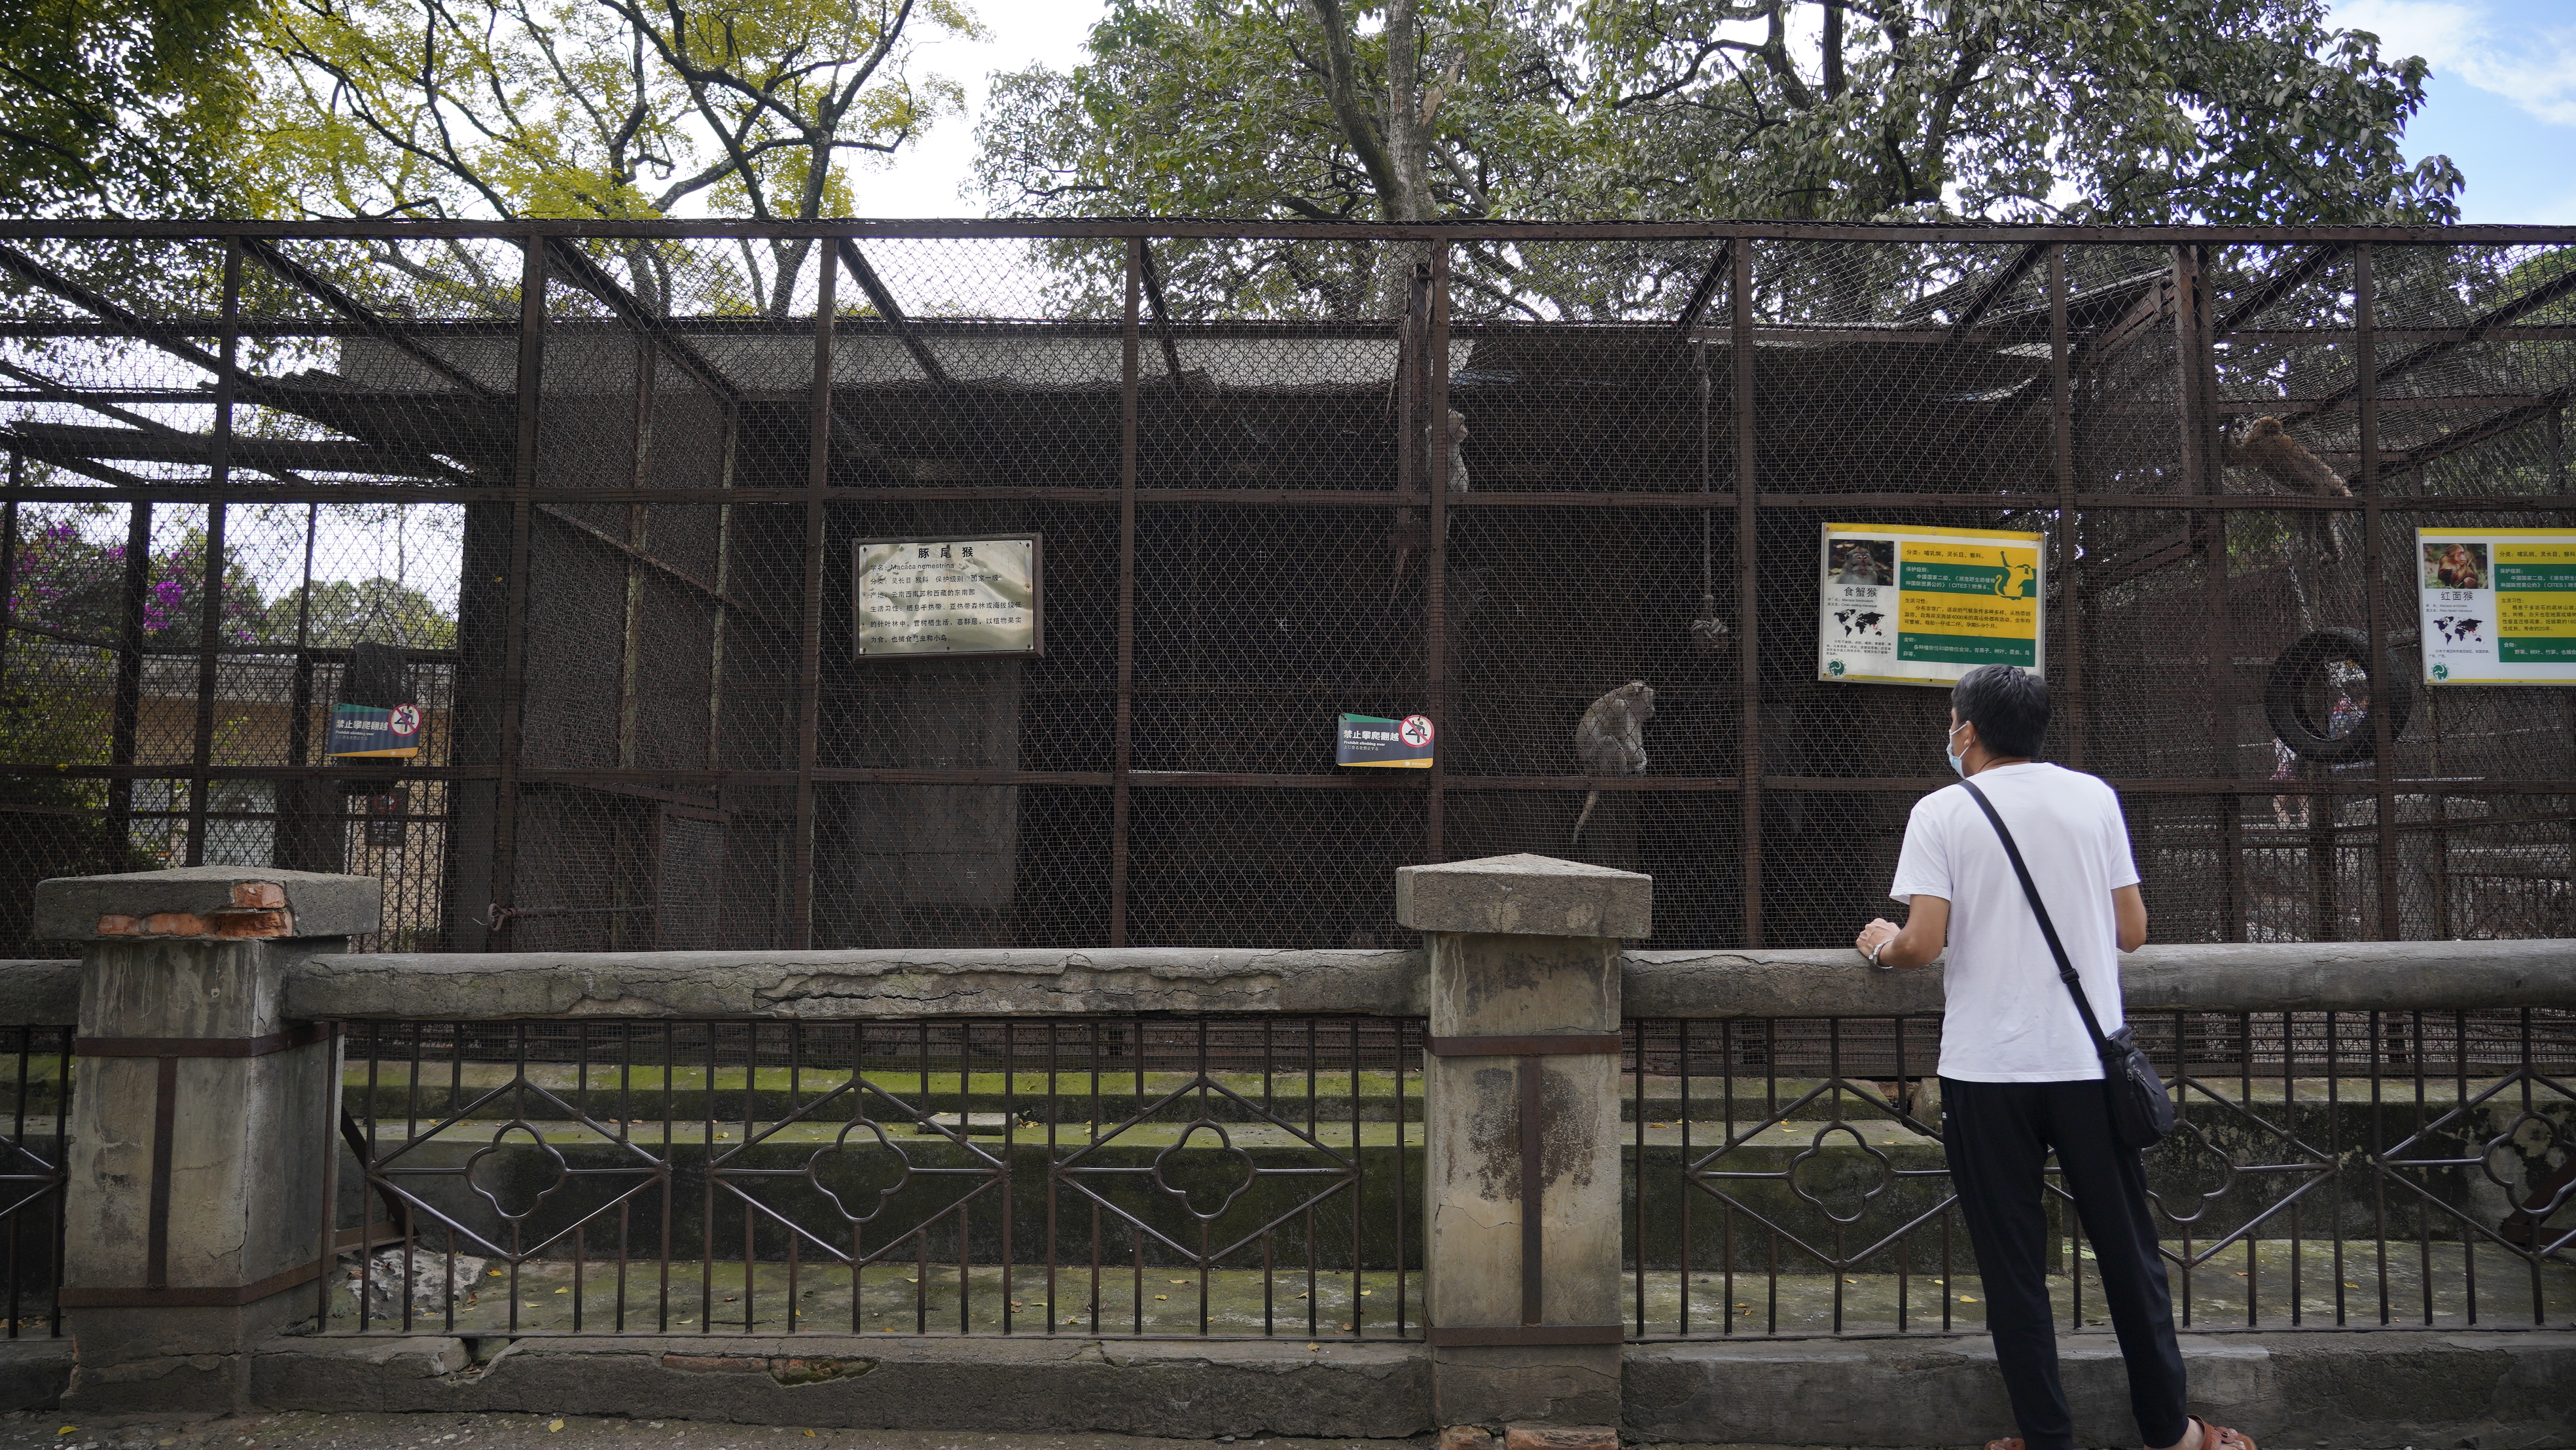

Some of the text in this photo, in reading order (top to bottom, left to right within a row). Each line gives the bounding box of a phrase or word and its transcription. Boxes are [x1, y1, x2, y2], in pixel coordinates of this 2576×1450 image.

[918, 547, 973, 558] 豚尾猴
[1844, 586, 1877, 597] 食蟹猴
[2441, 591, 2473, 601] 红面猴
[336, 719, 389, 731] 禁止攀爬翻越
[1343, 730, 1399, 741] 禁止攀爬翻越
